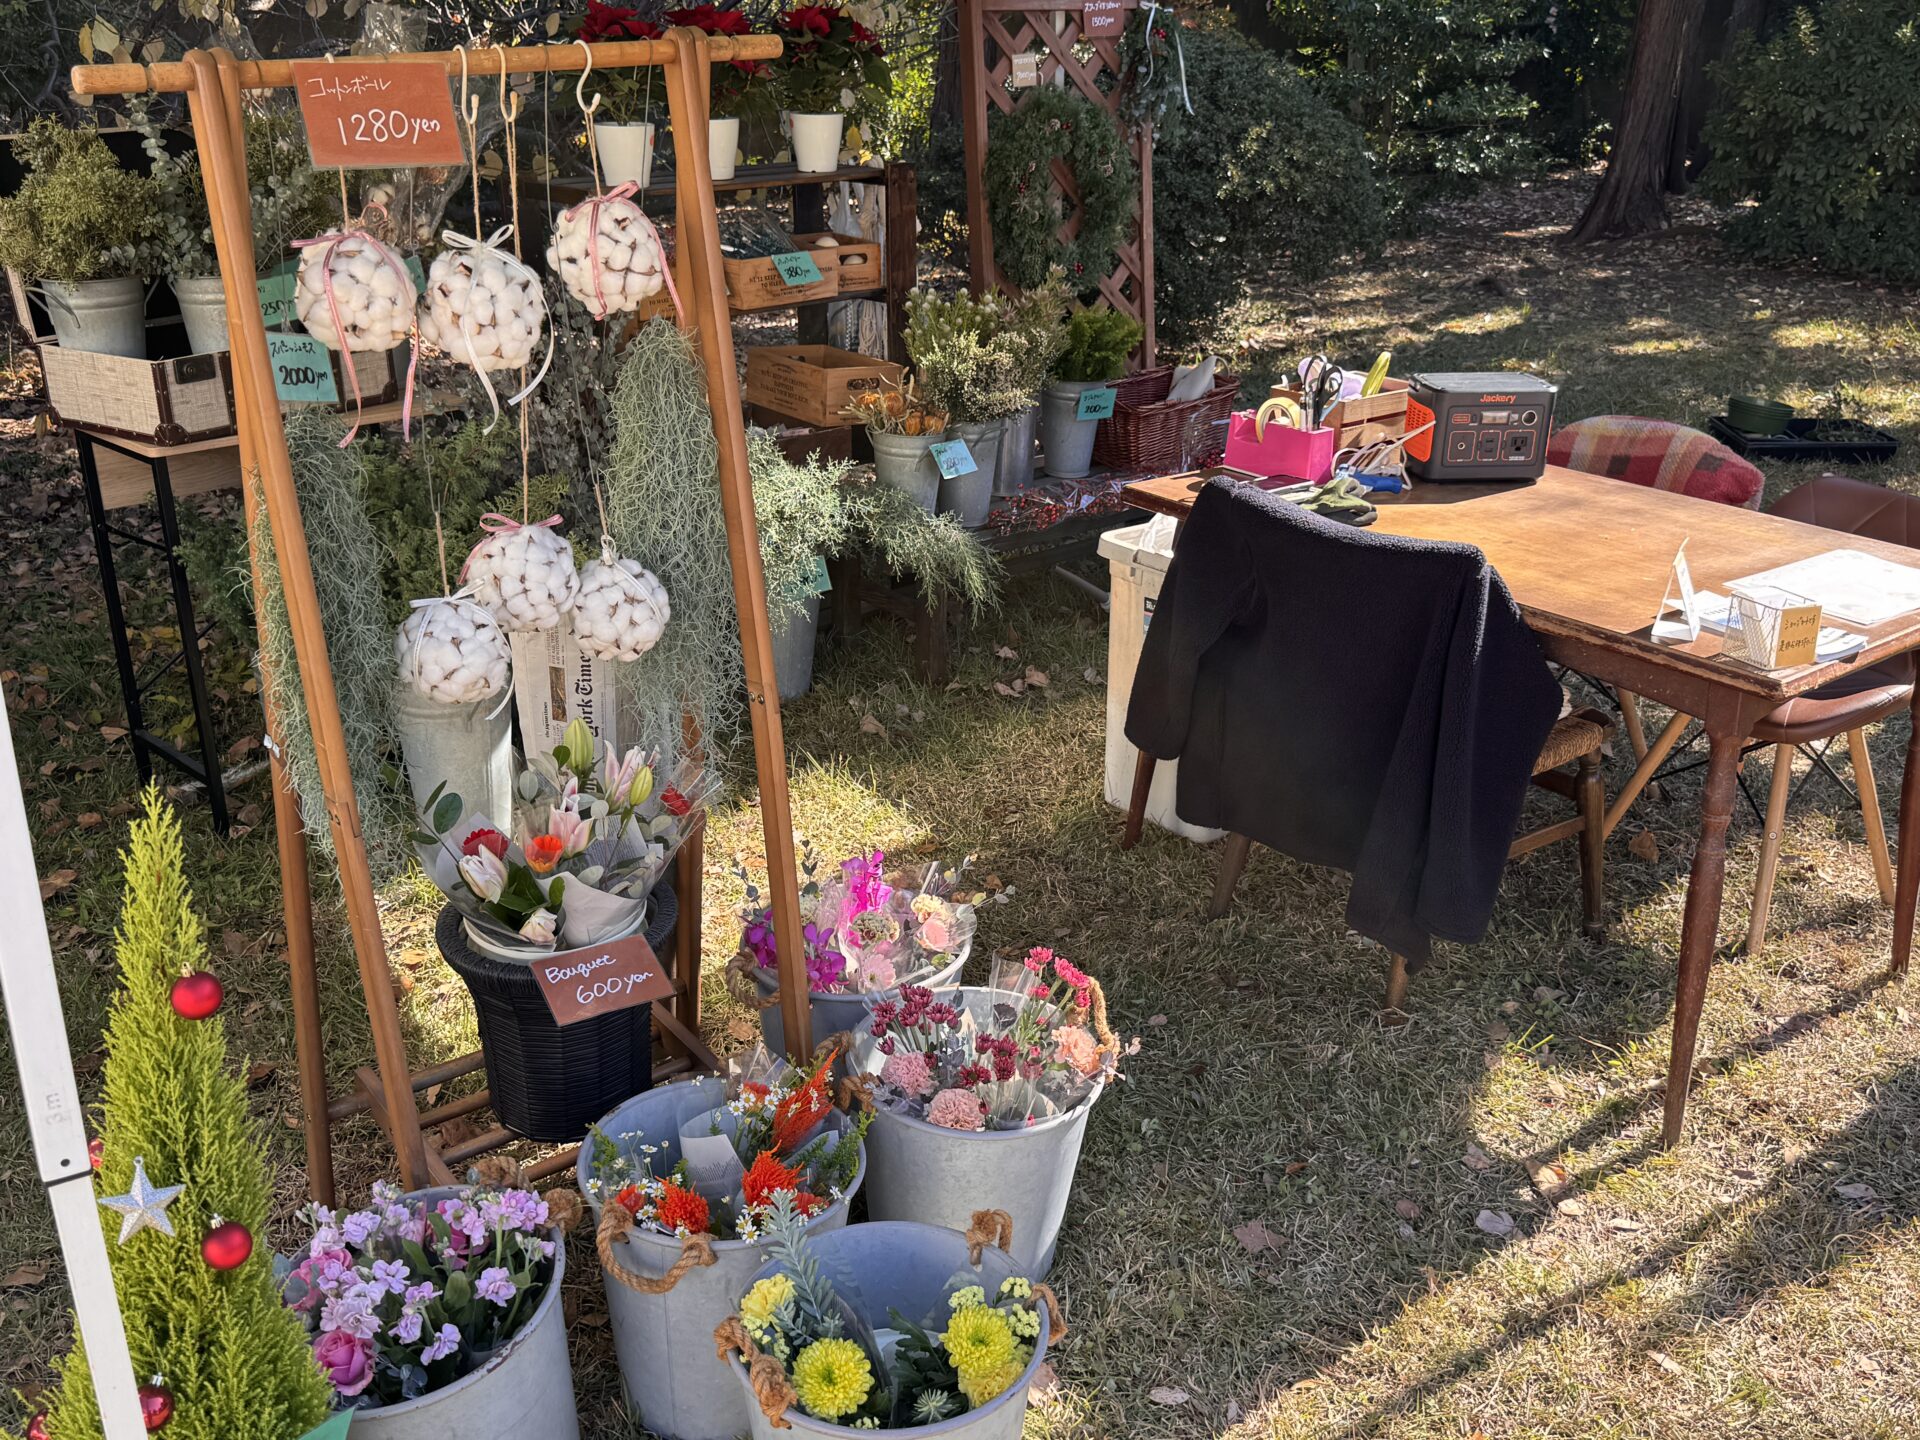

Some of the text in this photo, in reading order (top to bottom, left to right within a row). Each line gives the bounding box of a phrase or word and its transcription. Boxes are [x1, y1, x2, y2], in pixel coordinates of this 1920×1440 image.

[307, 75, 392, 101] コットンボール
[337, 108, 440, 146] 1280yen
[1480, 394, 1516, 404] Jackery
[575, 649, 593, 695] Time
[545, 954, 616, 984] Bouquet
